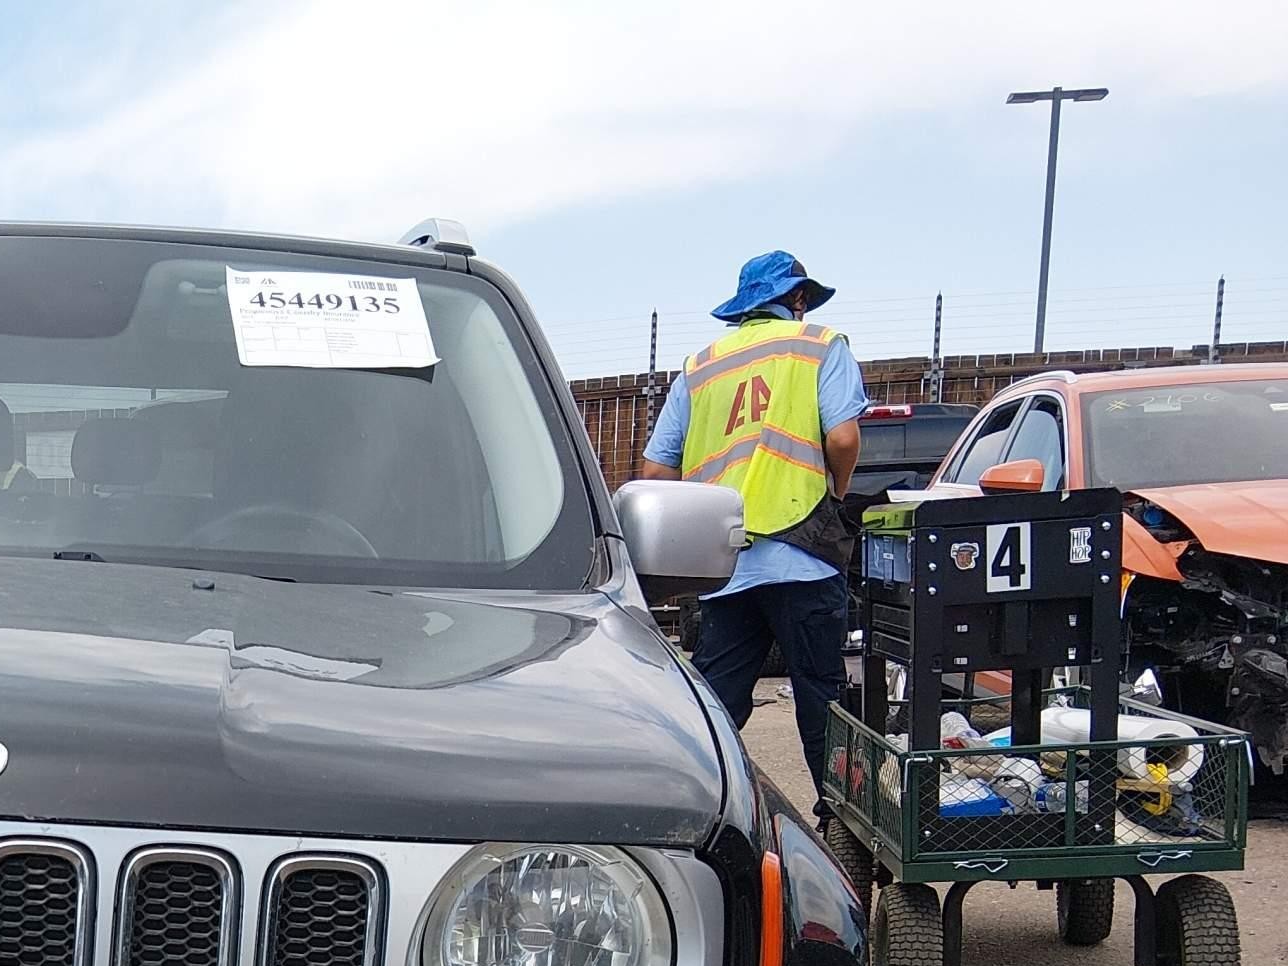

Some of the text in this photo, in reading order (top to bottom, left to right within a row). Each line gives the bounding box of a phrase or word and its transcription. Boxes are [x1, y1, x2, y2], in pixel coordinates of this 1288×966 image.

[249, 291, 401, 314] 45449135
[1072, 530, 1090, 547] HIP
[991, 526, 1026, 587] 4
[1072, 546, 1090, 560] HOP
